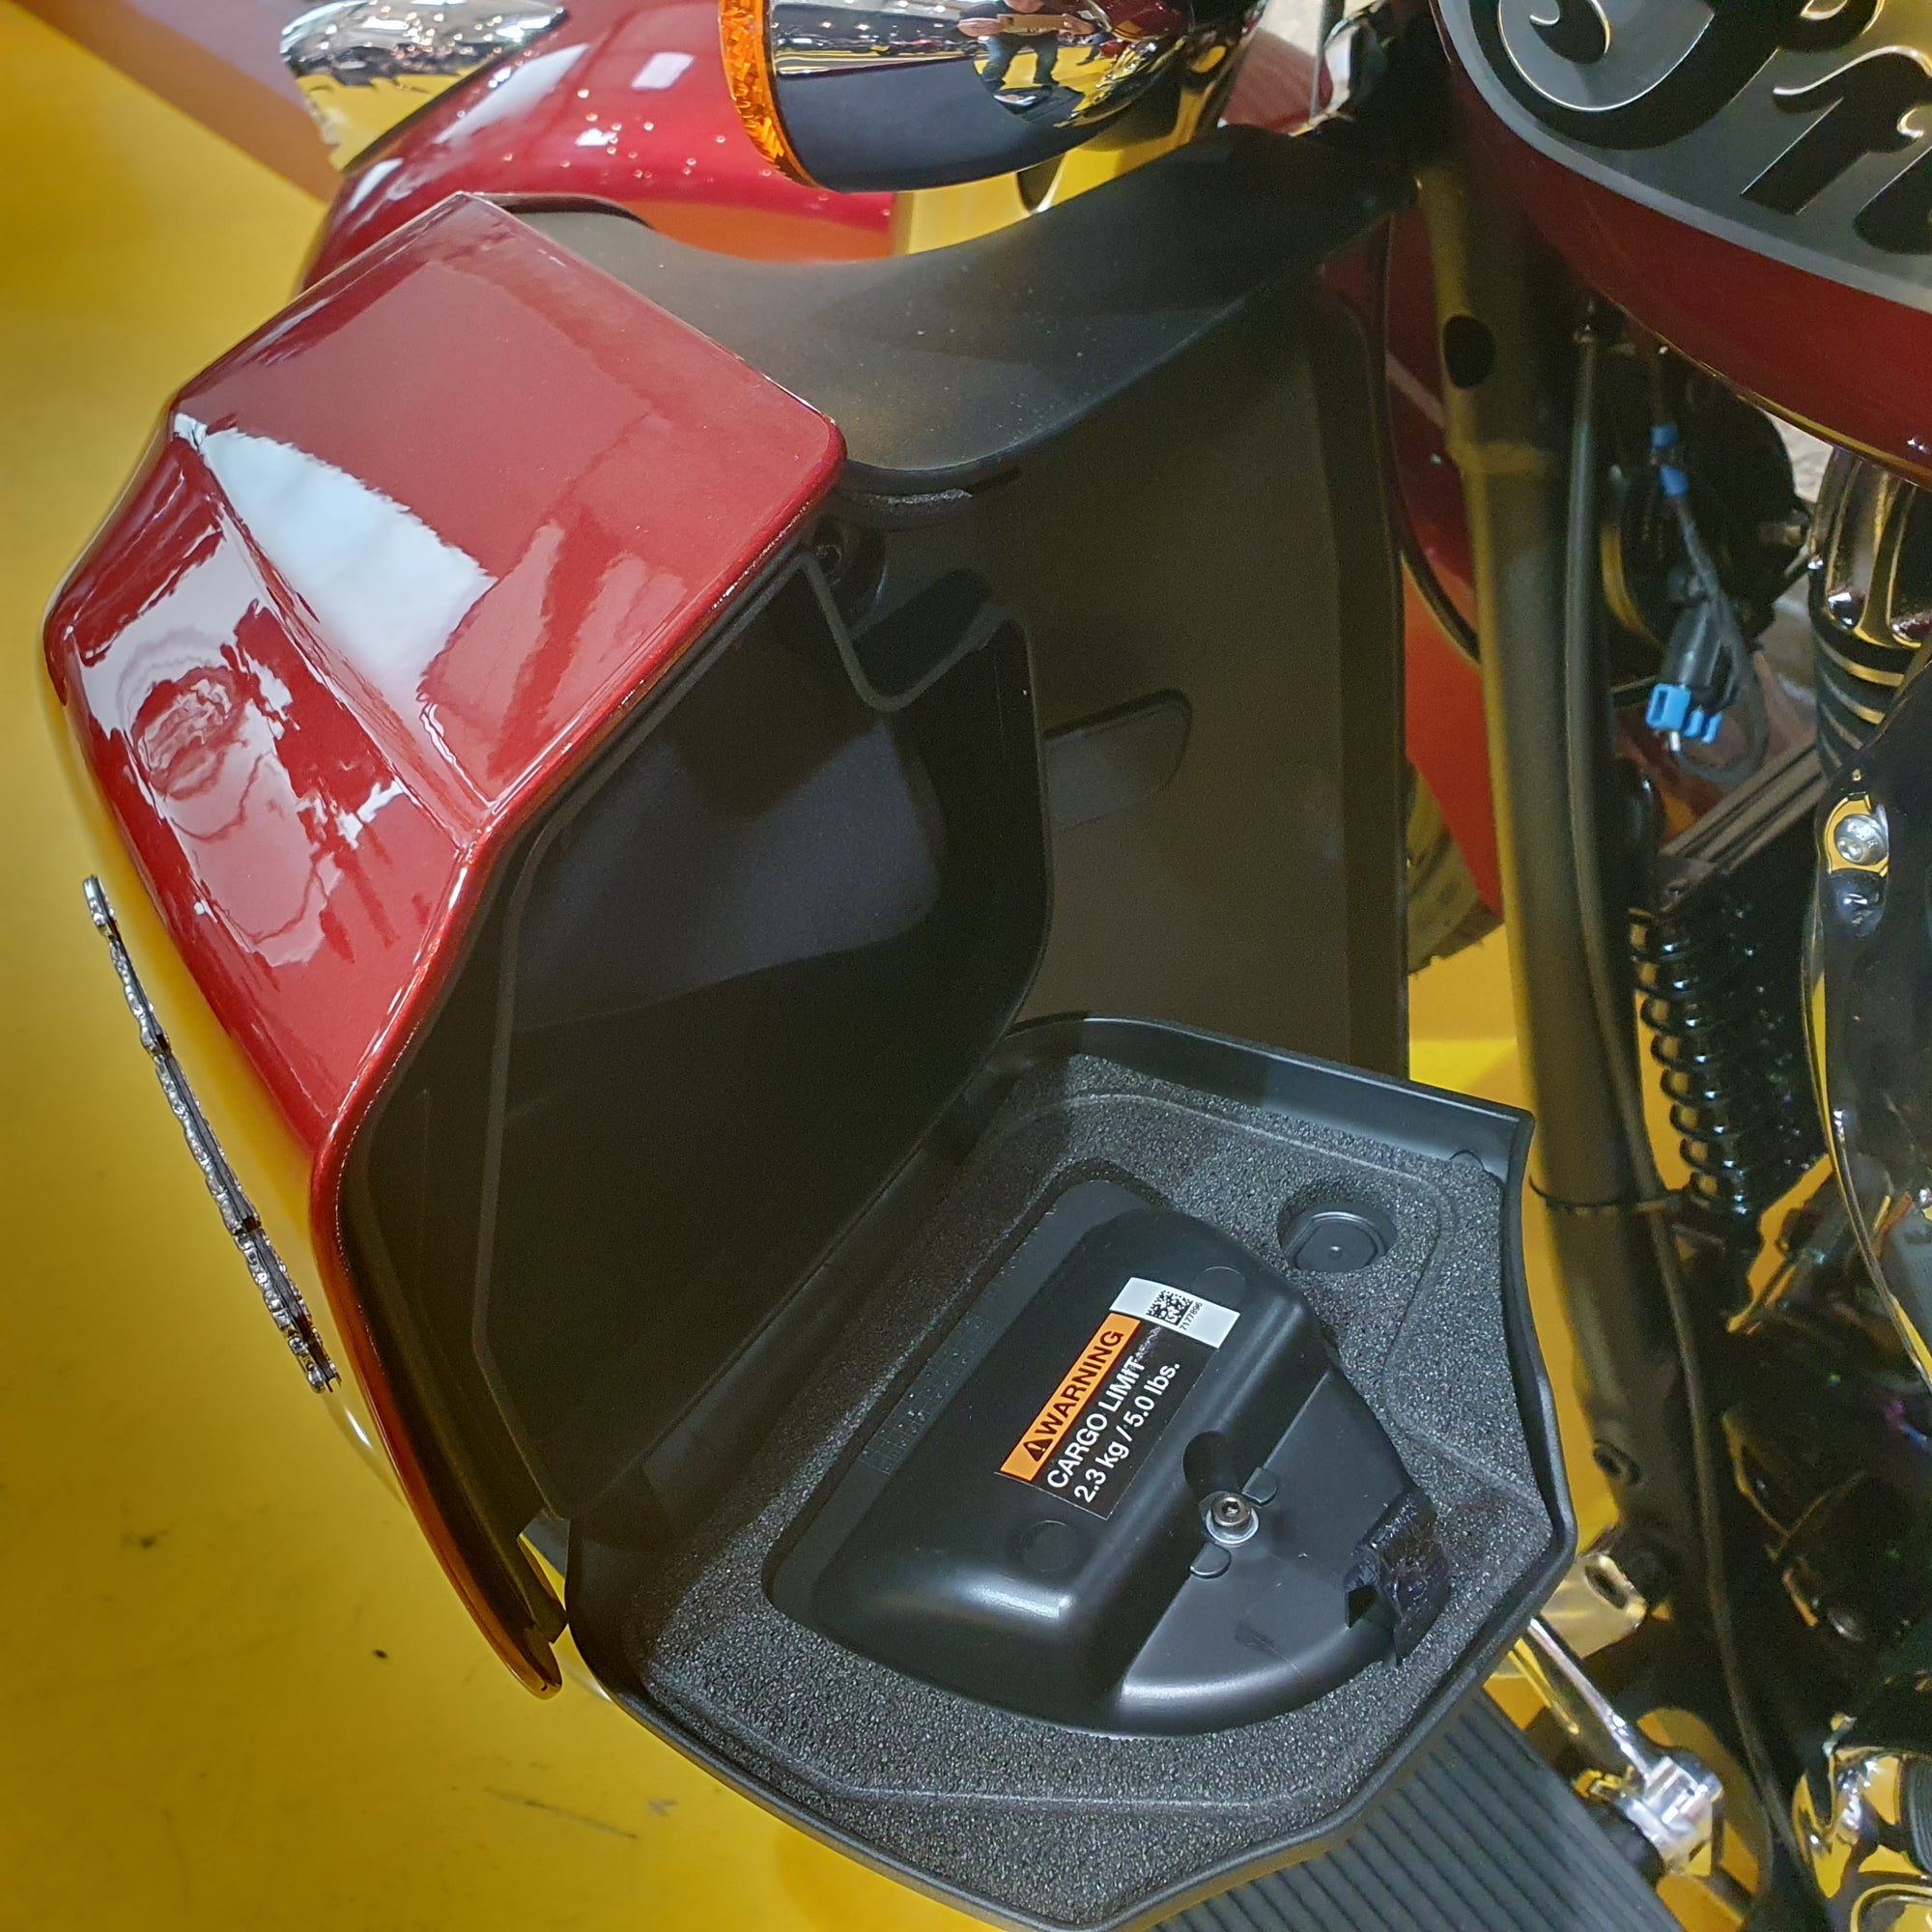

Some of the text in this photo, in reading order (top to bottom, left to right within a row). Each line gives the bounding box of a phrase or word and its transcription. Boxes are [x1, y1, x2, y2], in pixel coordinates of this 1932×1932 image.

[1179, 1301, 1203, 1330] 7177896
[1035, 1330, 1124, 1435] WARNING
[1047, 1355, 1146, 1488] CARGO LIMIT
[1074, 1363, 1180, 1503] 2.3 kg / 5.0 lbs.
